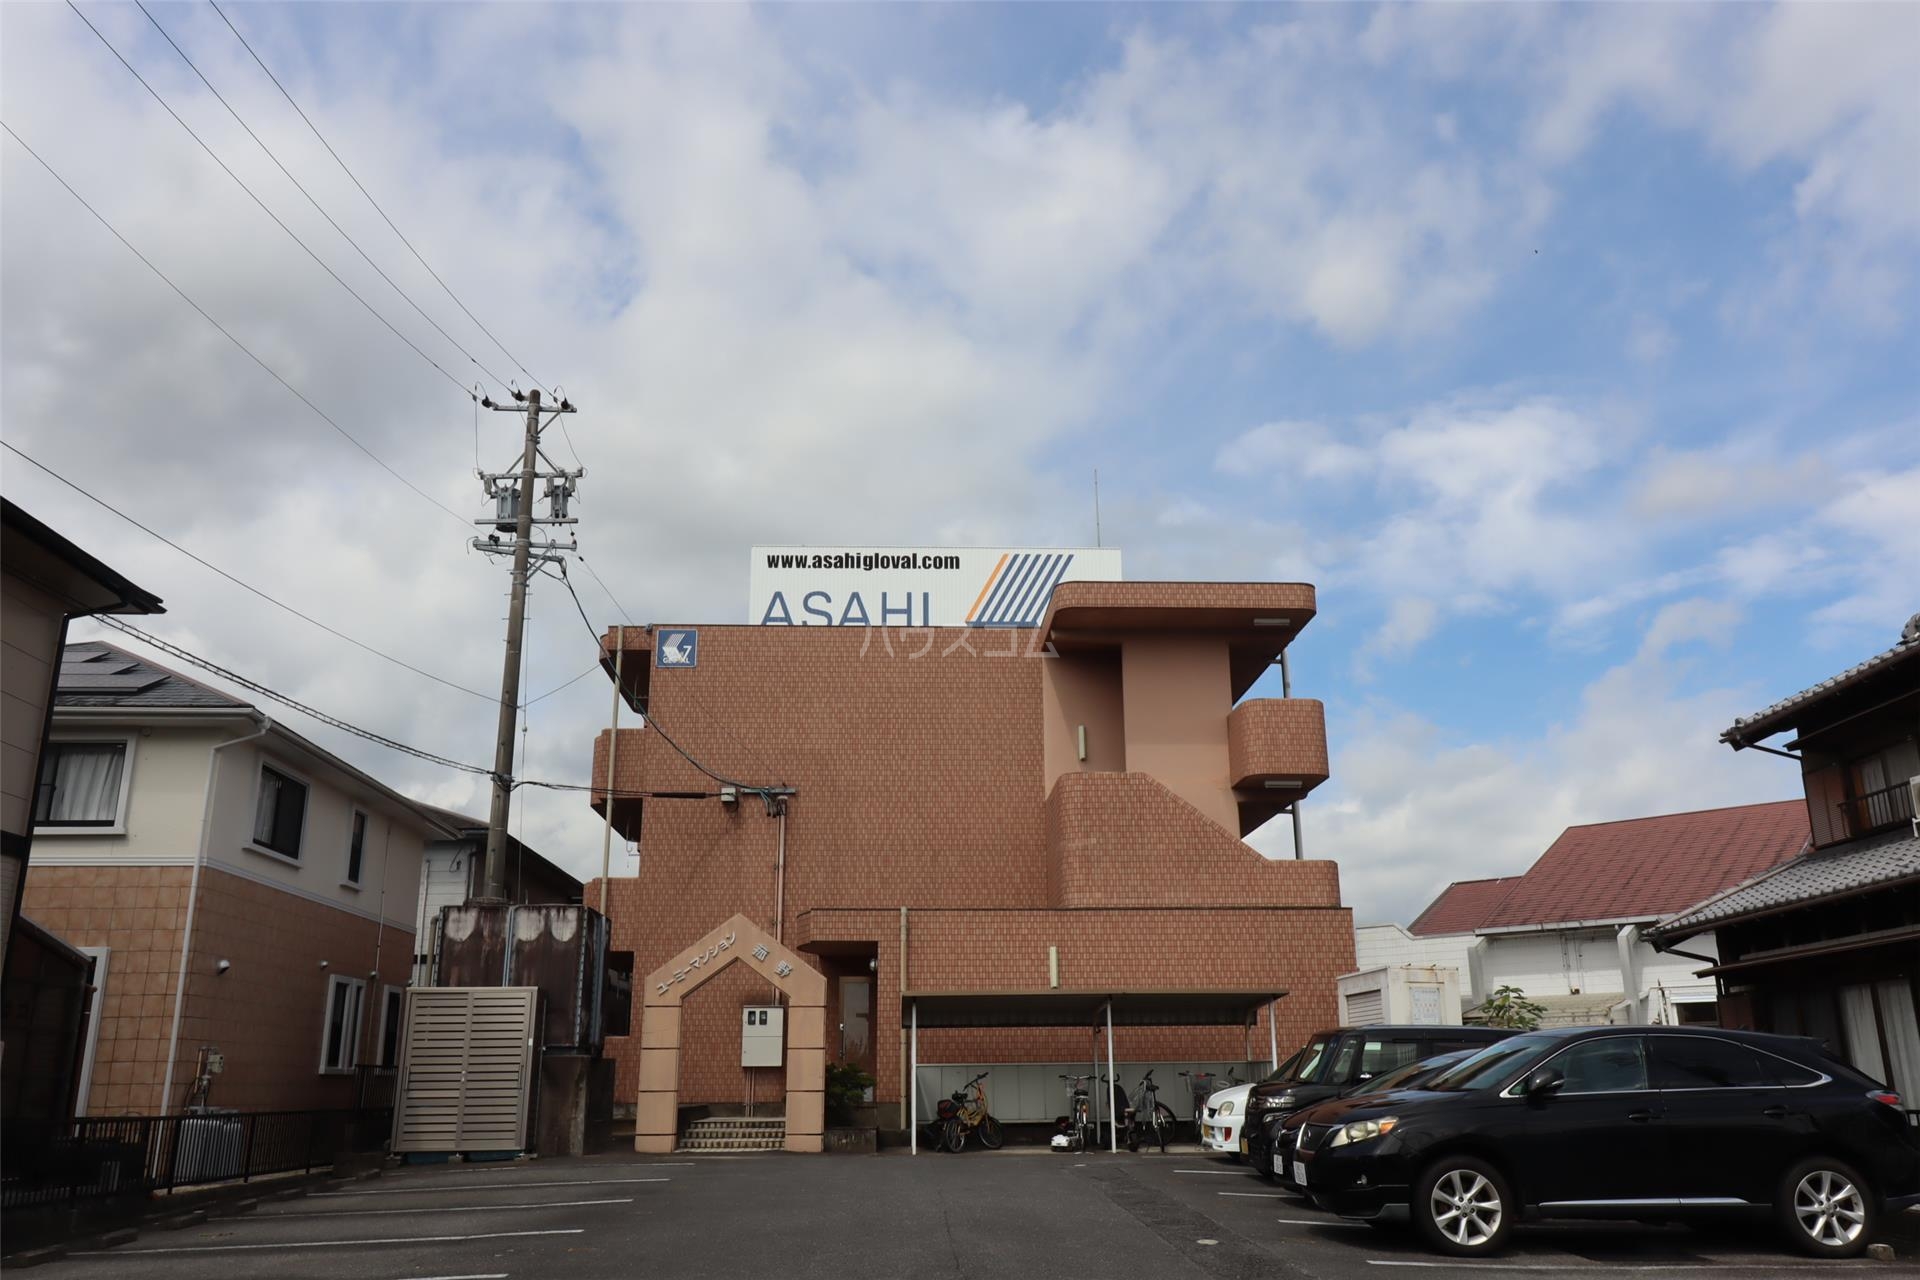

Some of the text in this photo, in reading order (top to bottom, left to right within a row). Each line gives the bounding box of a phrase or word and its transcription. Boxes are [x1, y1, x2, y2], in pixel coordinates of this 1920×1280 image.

[767, 552, 960, 571] www.asahigloval.com
[760, 590, 930, 626] ASAHI
[656, 931, 736, 997] ユーミーマンション
